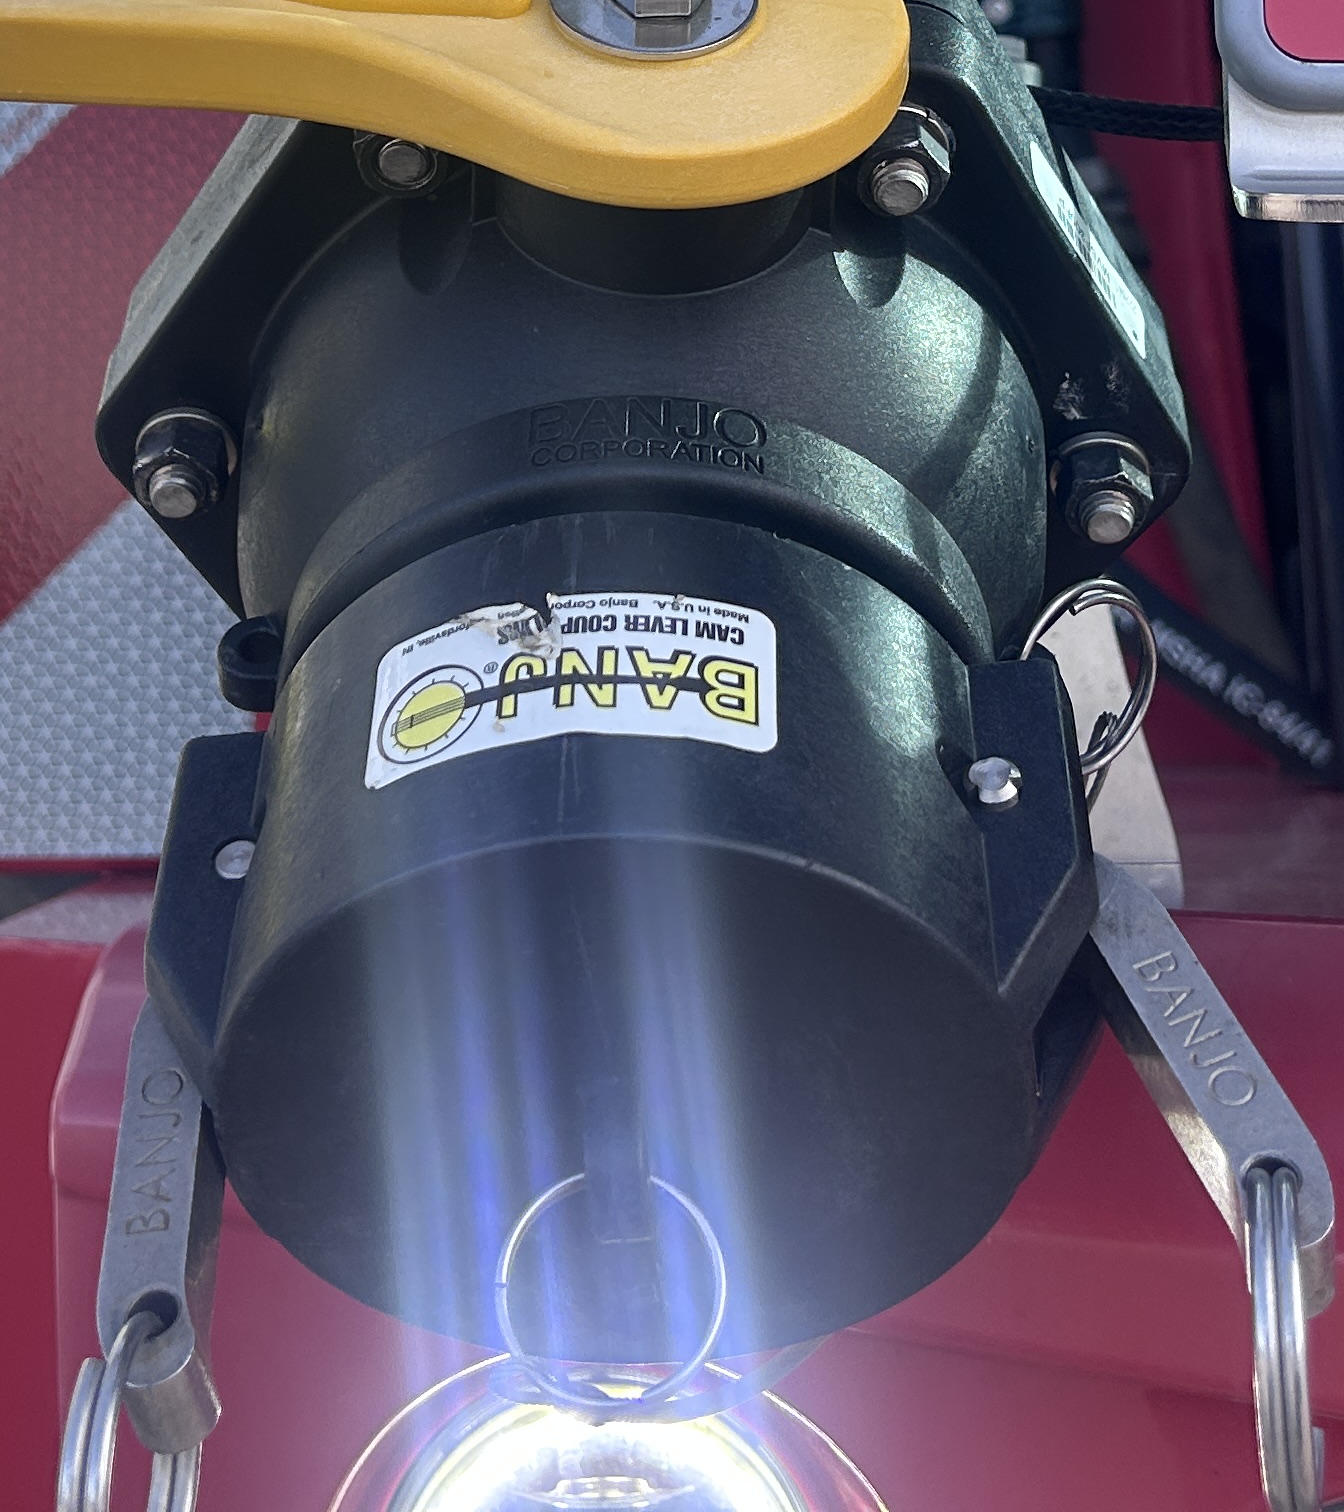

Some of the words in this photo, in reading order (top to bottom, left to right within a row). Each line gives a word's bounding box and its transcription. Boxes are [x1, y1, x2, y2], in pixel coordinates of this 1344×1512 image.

[529, 396, 767, 448] BANJO
[532, 439, 764, 475] CORPORATION
[598, 597, 639, 609] Banjo
[698, 605, 711, 616] in
[714, 606, 750, 625] Made
[624, 613, 689, 637] LEVER
[695, 620, 745, 646] CAM
[1133, 950, 1258, 1106] BANJO
[125, 1065, 185, 1235] BANJO
